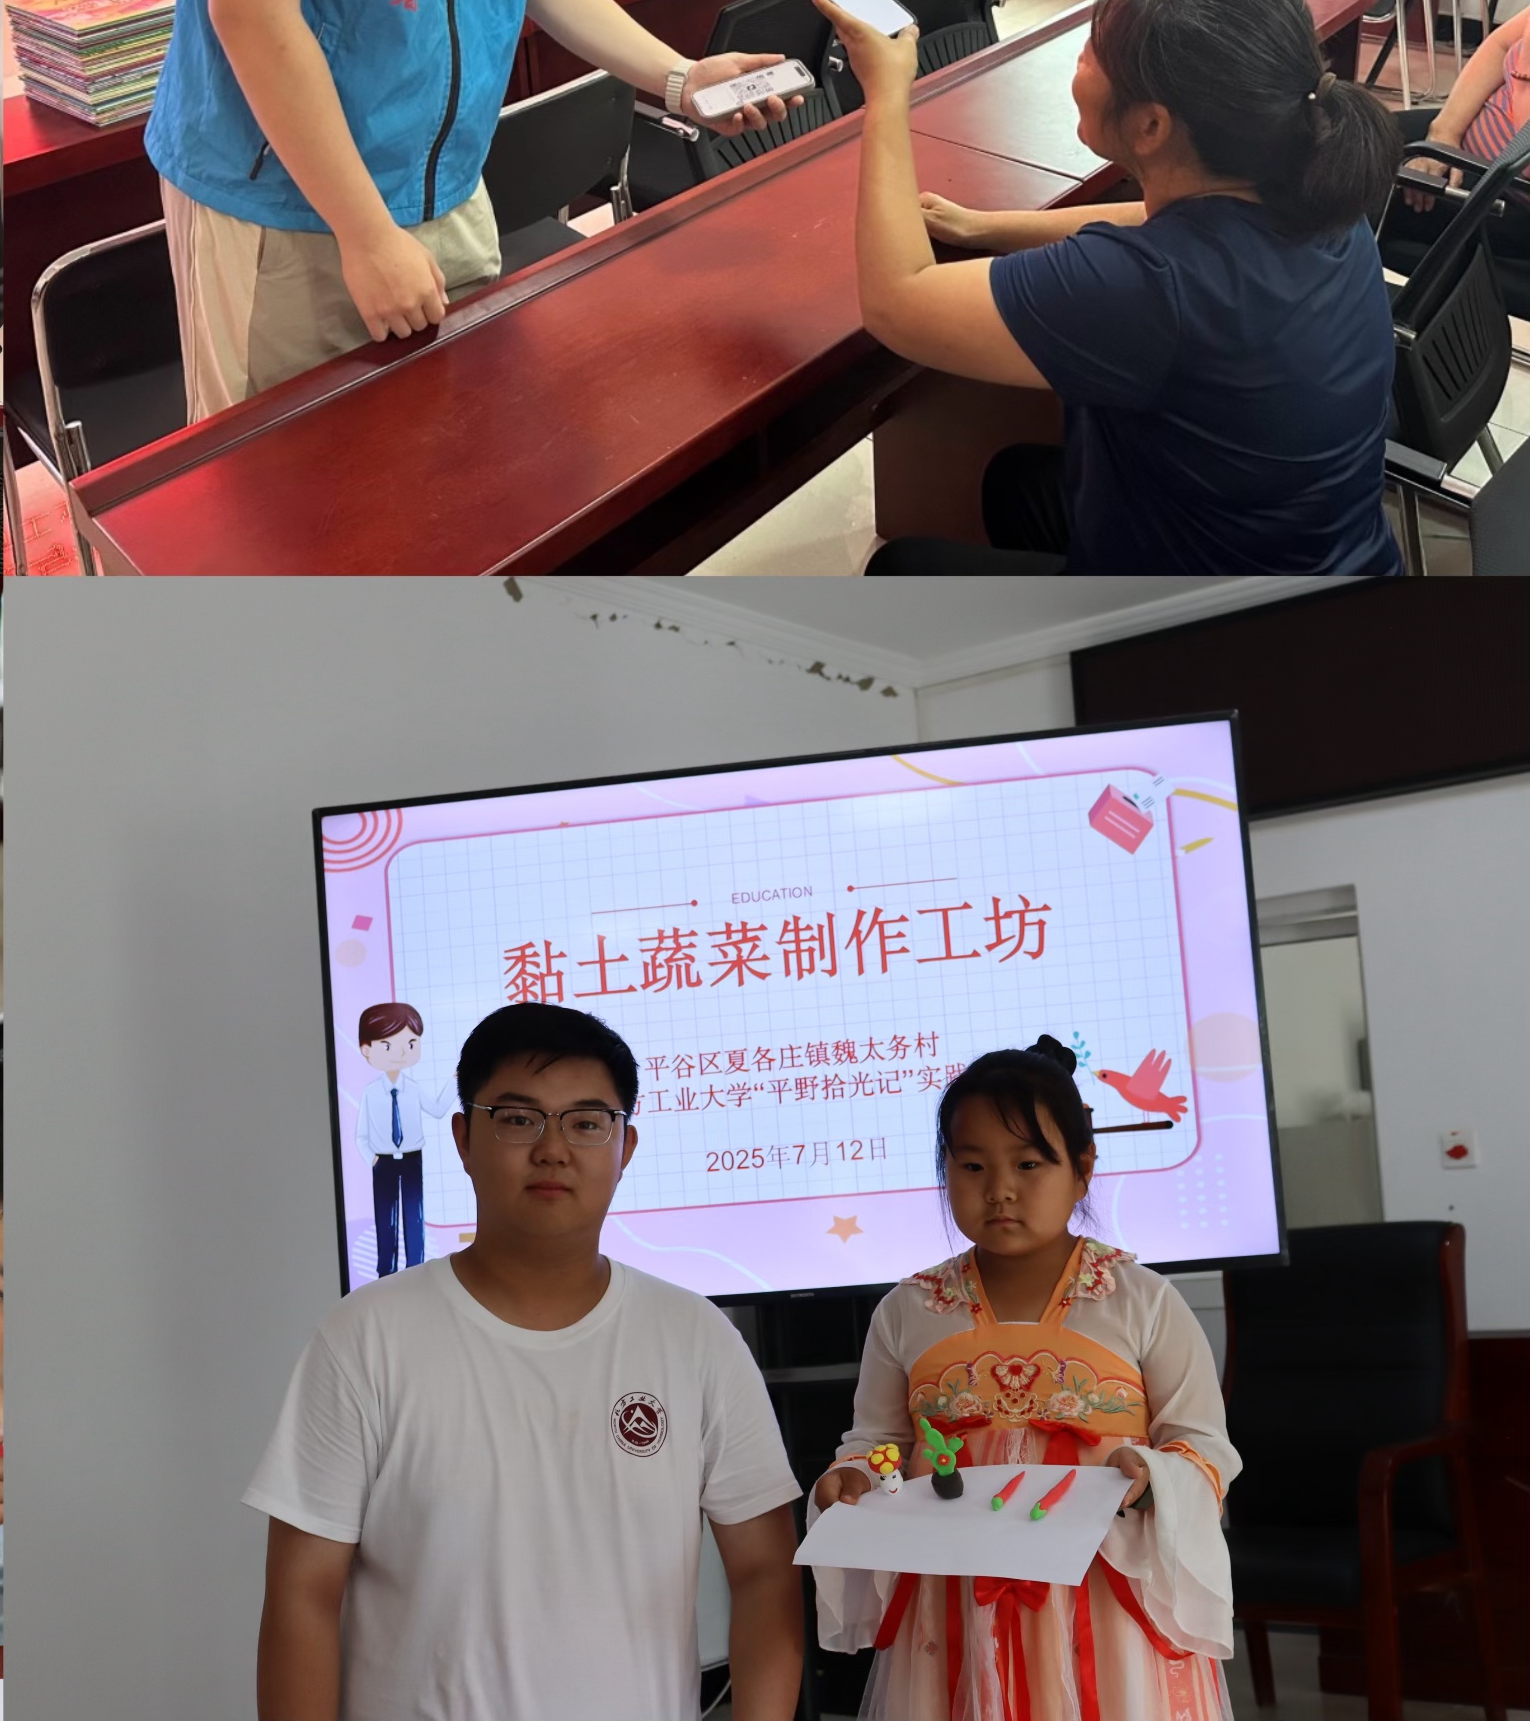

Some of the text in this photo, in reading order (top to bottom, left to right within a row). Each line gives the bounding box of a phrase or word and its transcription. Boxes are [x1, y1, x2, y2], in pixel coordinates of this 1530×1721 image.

[731, 885, 814, 907] EDUCATION
[502, 893, 1054, 1007] 黏土蔬菜制作工坊
[644, 1030, 940, 1082] 平谷区夏各庄镇魏太务村
[706, 1137, 887, 1173] 2025年7月12日
